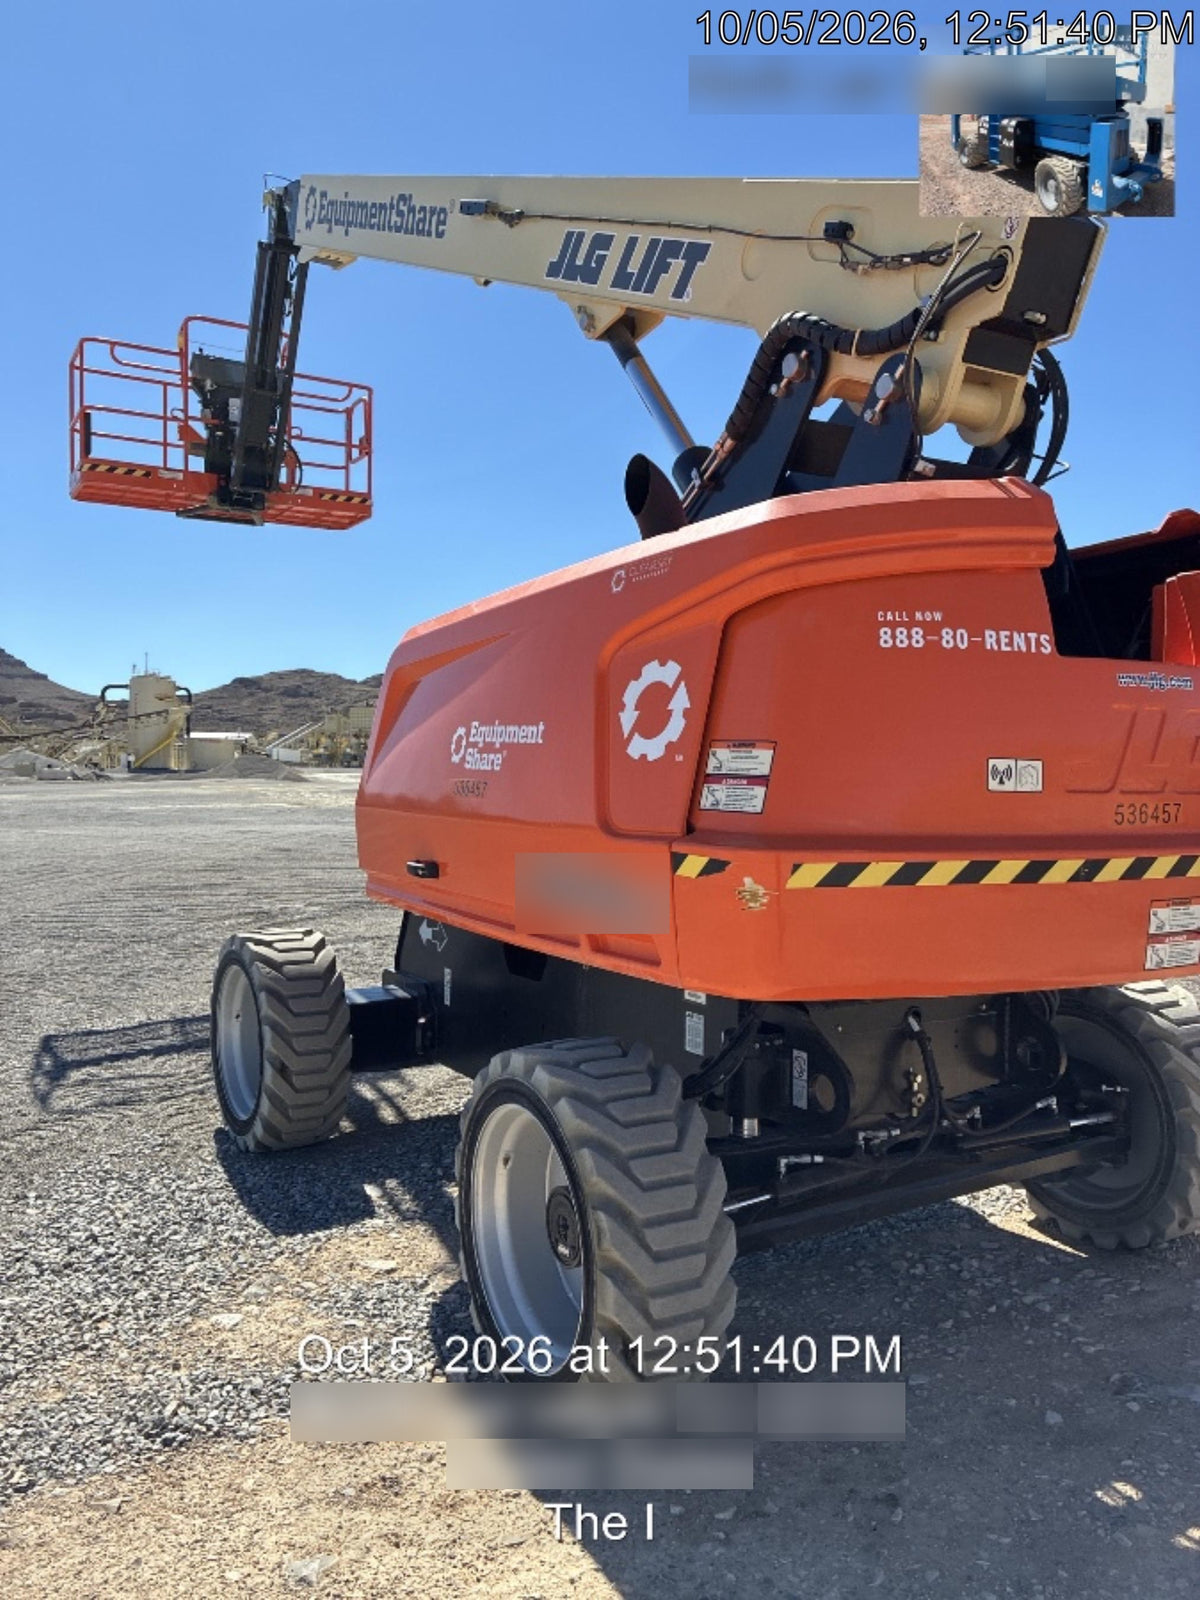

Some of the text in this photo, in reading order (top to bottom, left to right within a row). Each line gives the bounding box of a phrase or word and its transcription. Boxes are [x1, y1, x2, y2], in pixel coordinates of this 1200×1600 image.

[545, 228, 714, 302] JLG LIFT
[877, 610, 944, 622] CALL NOW
[878, 626, 1053, 655] 888-80-RENTS
[469, 720, 545, 748] Equipment
[464, 747, 503, 771] Share
[1114, 802, 1182, 826] 536457
